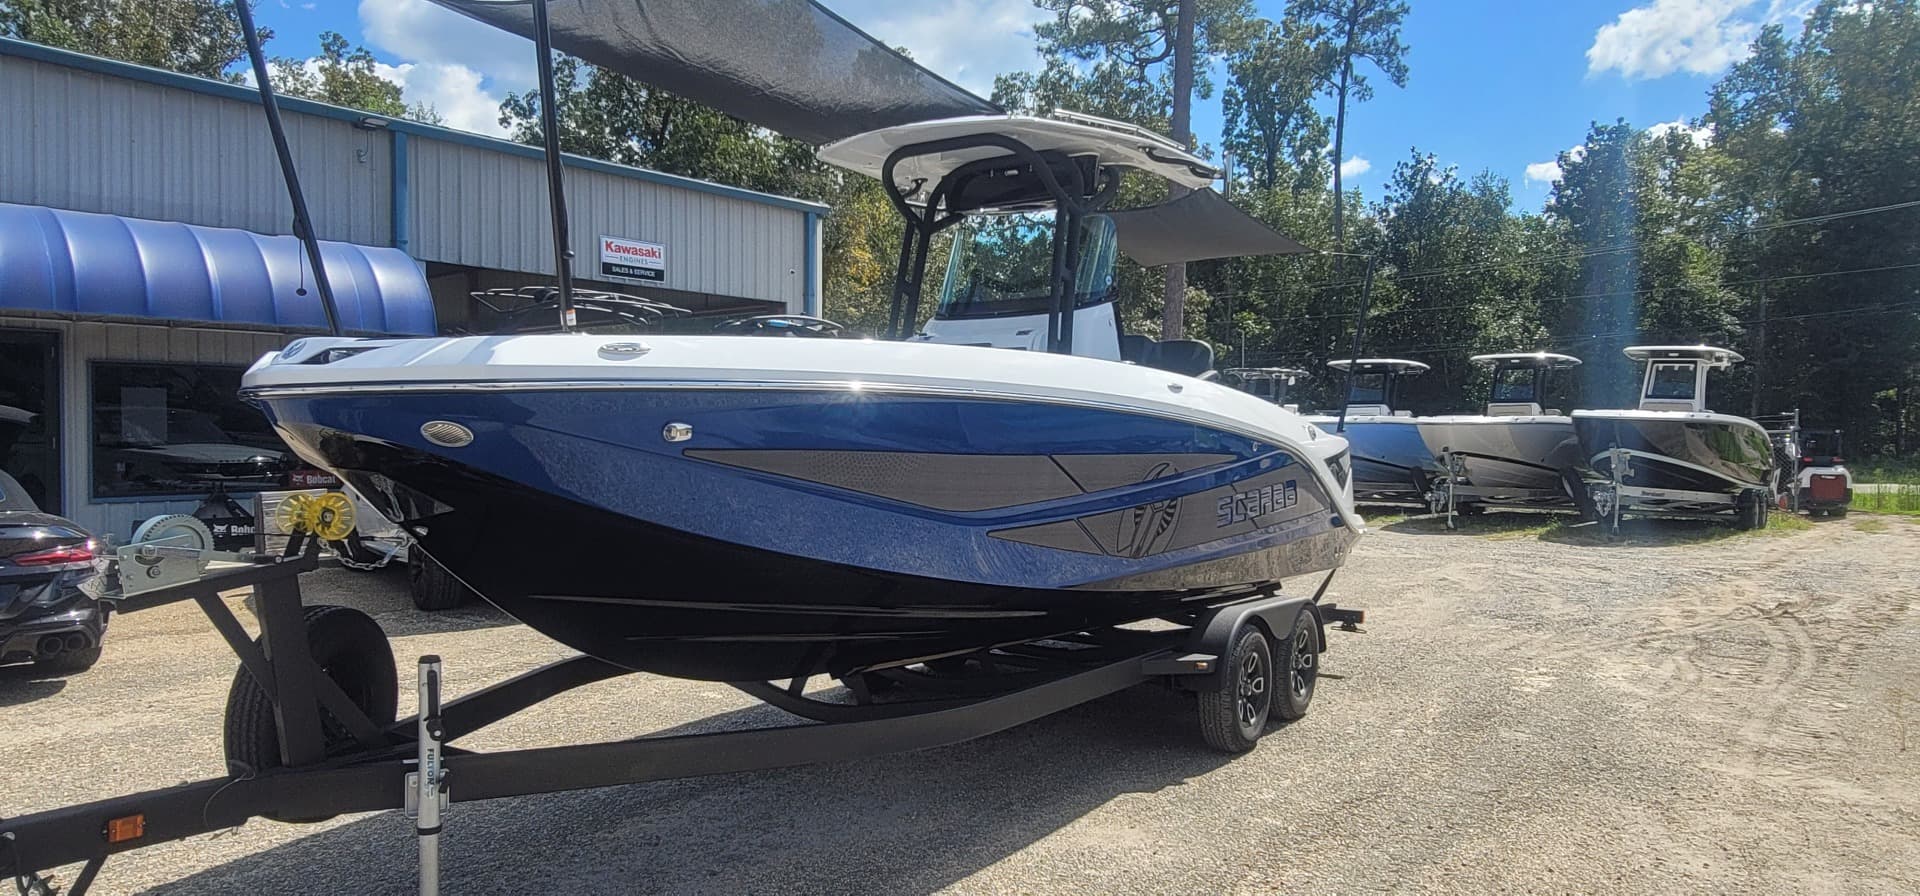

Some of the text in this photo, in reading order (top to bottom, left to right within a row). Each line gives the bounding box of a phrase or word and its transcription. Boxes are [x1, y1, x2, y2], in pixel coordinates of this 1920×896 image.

[604, 240, 662, 259] Kawasaki
[612, 266, 629, 274] SALES
[634, 269, 656, 277] SERVICE
[306, 474, 336, 484] Bobcat
[230, 524, 256, 536] Bobc
[427, 748, 435, 785] FULTON
